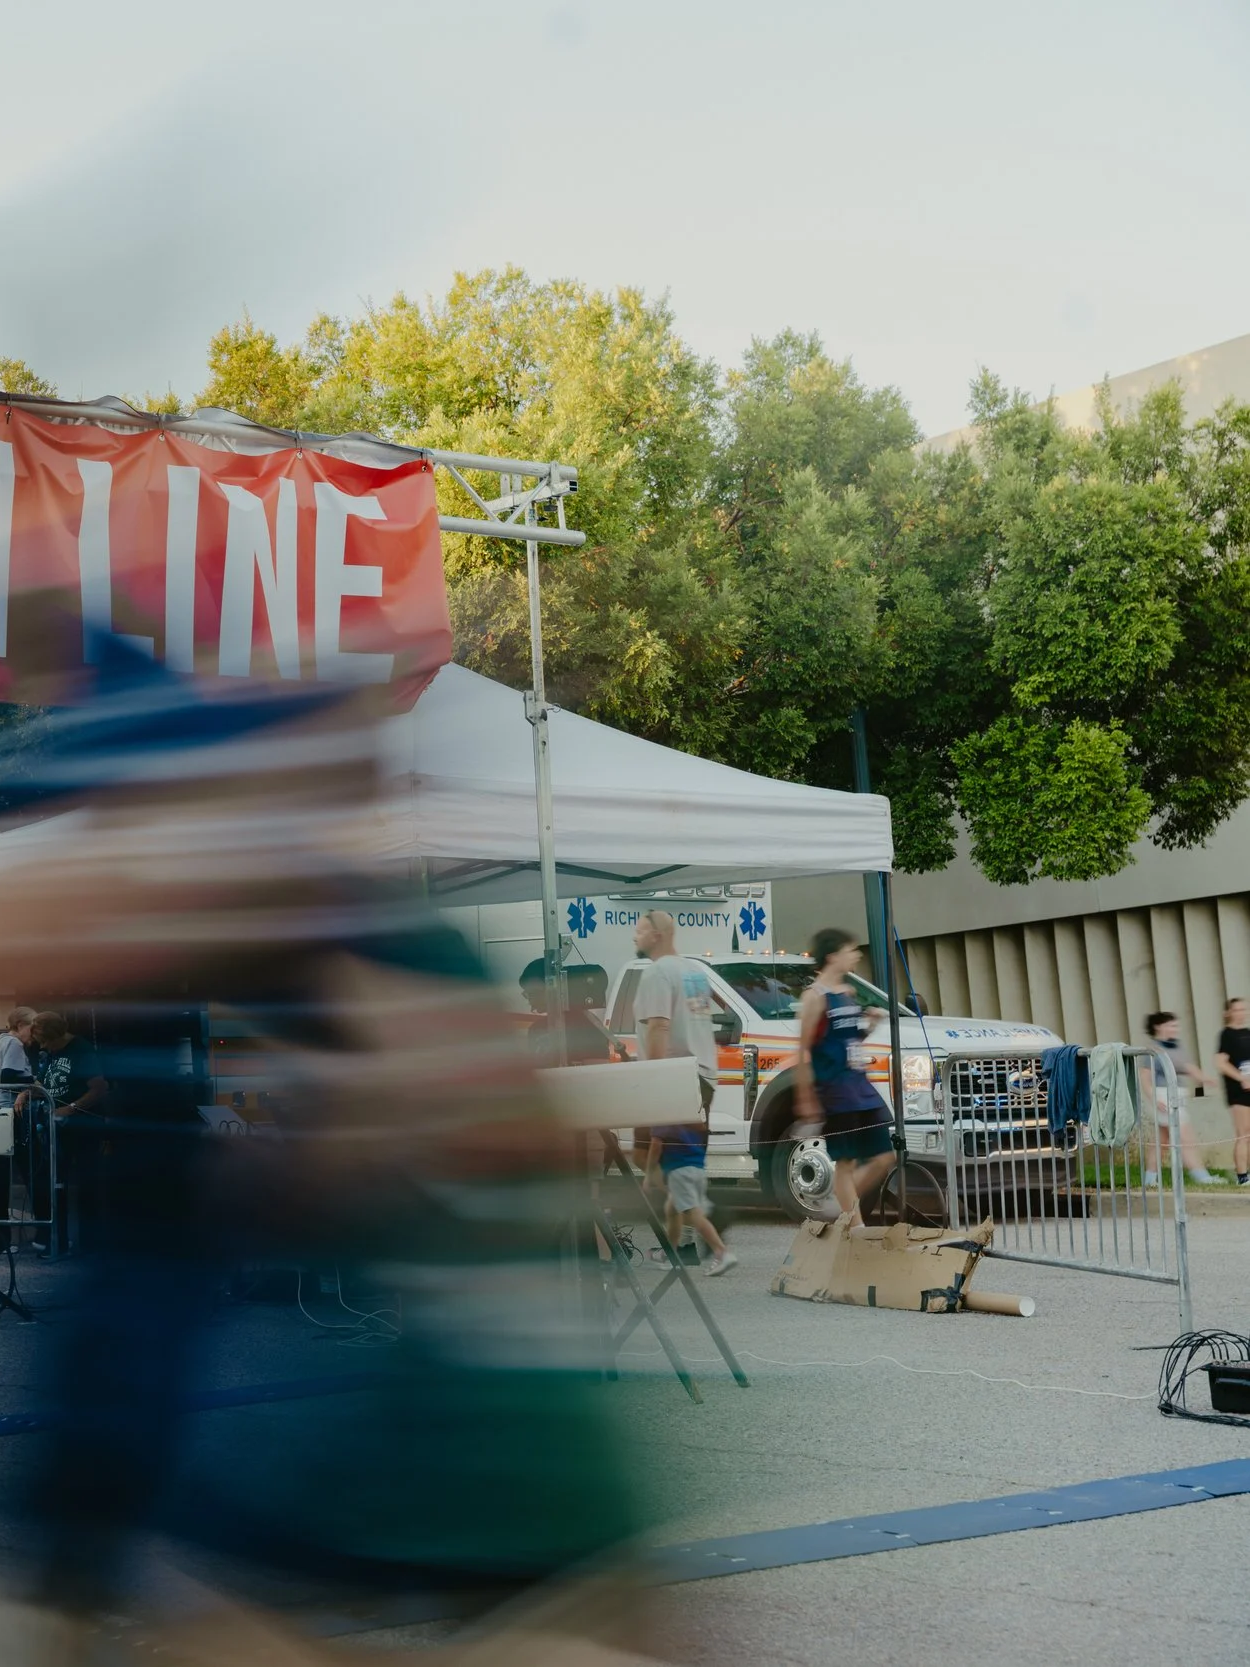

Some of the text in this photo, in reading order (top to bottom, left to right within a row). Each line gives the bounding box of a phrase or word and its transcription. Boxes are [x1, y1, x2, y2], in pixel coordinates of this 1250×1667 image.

[76, 457, 396, 684] LINE
[605, 911, 731, 927] RICH COUNTY
